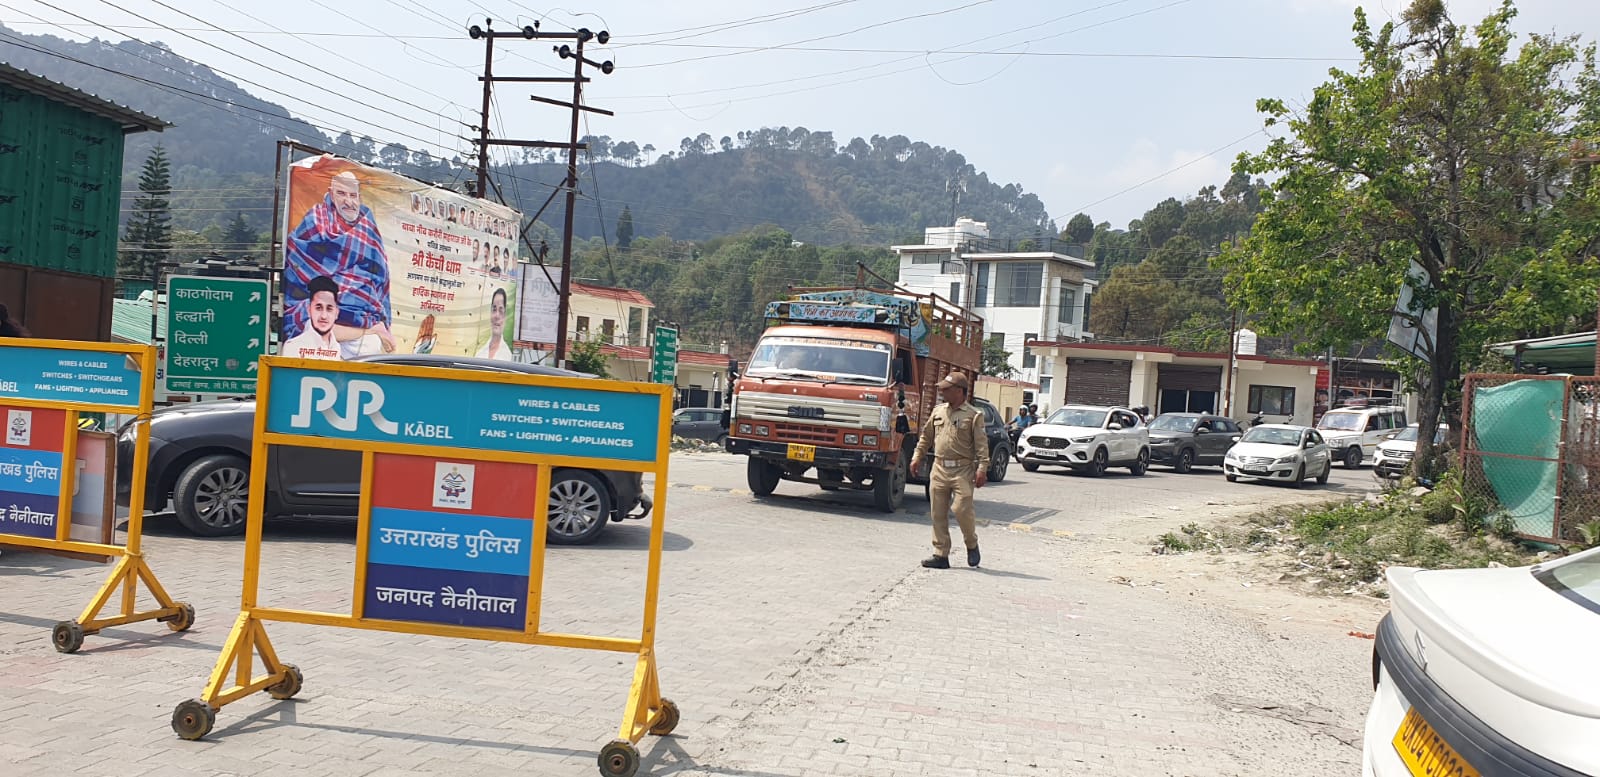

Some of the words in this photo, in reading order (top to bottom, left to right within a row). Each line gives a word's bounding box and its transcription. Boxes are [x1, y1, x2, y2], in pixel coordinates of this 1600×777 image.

[412, 251, 424, 267] श्री
[426, 251, 444, 272] कैंची
[446, 261, 462, 275] धाम
[176, 286, 233, 301] काठगोदाम
[175, 309, 215, 323] हल्द्वानी
[174, 330, 208, 344] दिल्ली
[173, 353, 219, 371] देहरादून
[78, 374, 122, 382] SWITCHGEARS
[56, 385, 84, 393] LIGHTING
[89, 388, 128, 396] APPLIANCES
[290, 376, 399, 435] RR
[518, 399, 550, 408] WIRES
[561, 402, 600, 412] CABLES
[404, 421, 454, 439] KĀBEL
[491, 413, 543, 424] SWITCHES
[552, 418, 624, 430] SWITCHGEARS
[480, 429, 506, 438] FANS
[516, 432, 562, 442] LIGHTING
[572, 436, 634, 447] APPLIANCES
[25, 460, 58, 482] पुलिस
[9, 504, 54, 526] नैनीताल
[380, 527, 459, 549] उत्तराखंड
[464, 529, 521, 558] पुलिस
[376, 586, 436, 608] जनपद
[441, 585, 518, 614] नैनीताल
